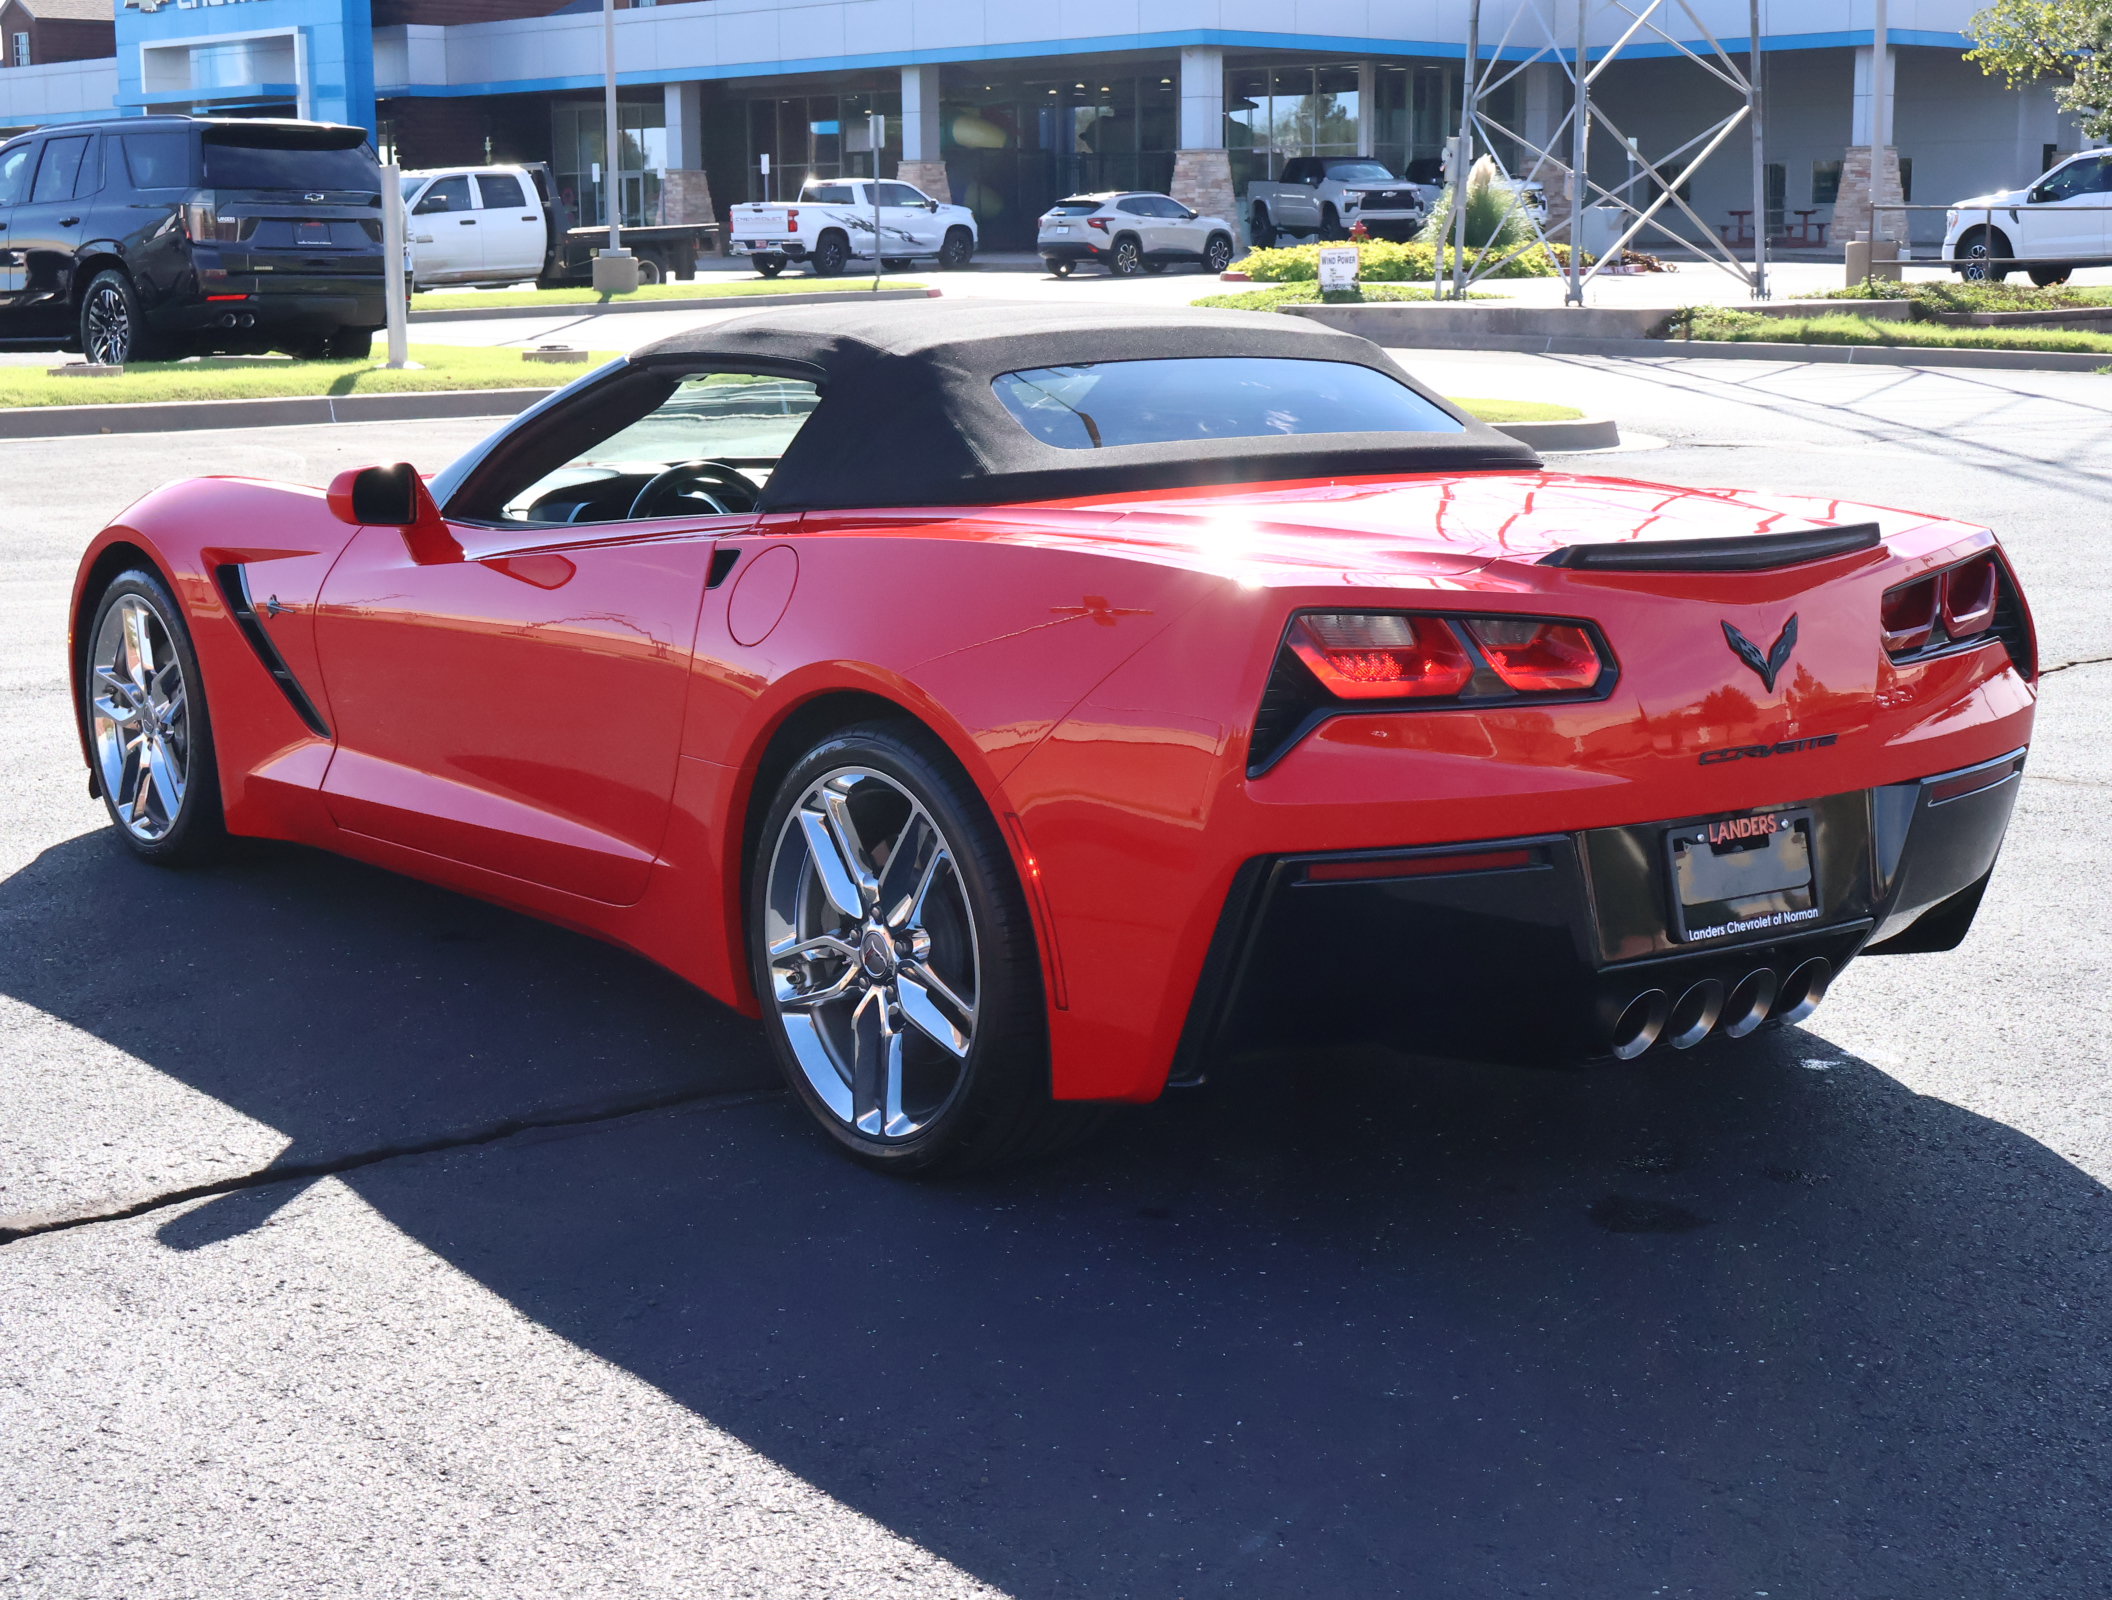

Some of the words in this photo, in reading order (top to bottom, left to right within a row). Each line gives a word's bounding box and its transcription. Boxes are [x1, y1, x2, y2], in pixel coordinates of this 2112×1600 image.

[1699, 733, 1839, 766] CORVETTE
[1708, 813, 1777, 845] LANDERS
[1688, 925, 1725, 942] Landers
[1727, 914, 1771, 934] Chevrolet
[1773, 914, 1782, 926] of
[1783, 908, 1819, 924] Norman
